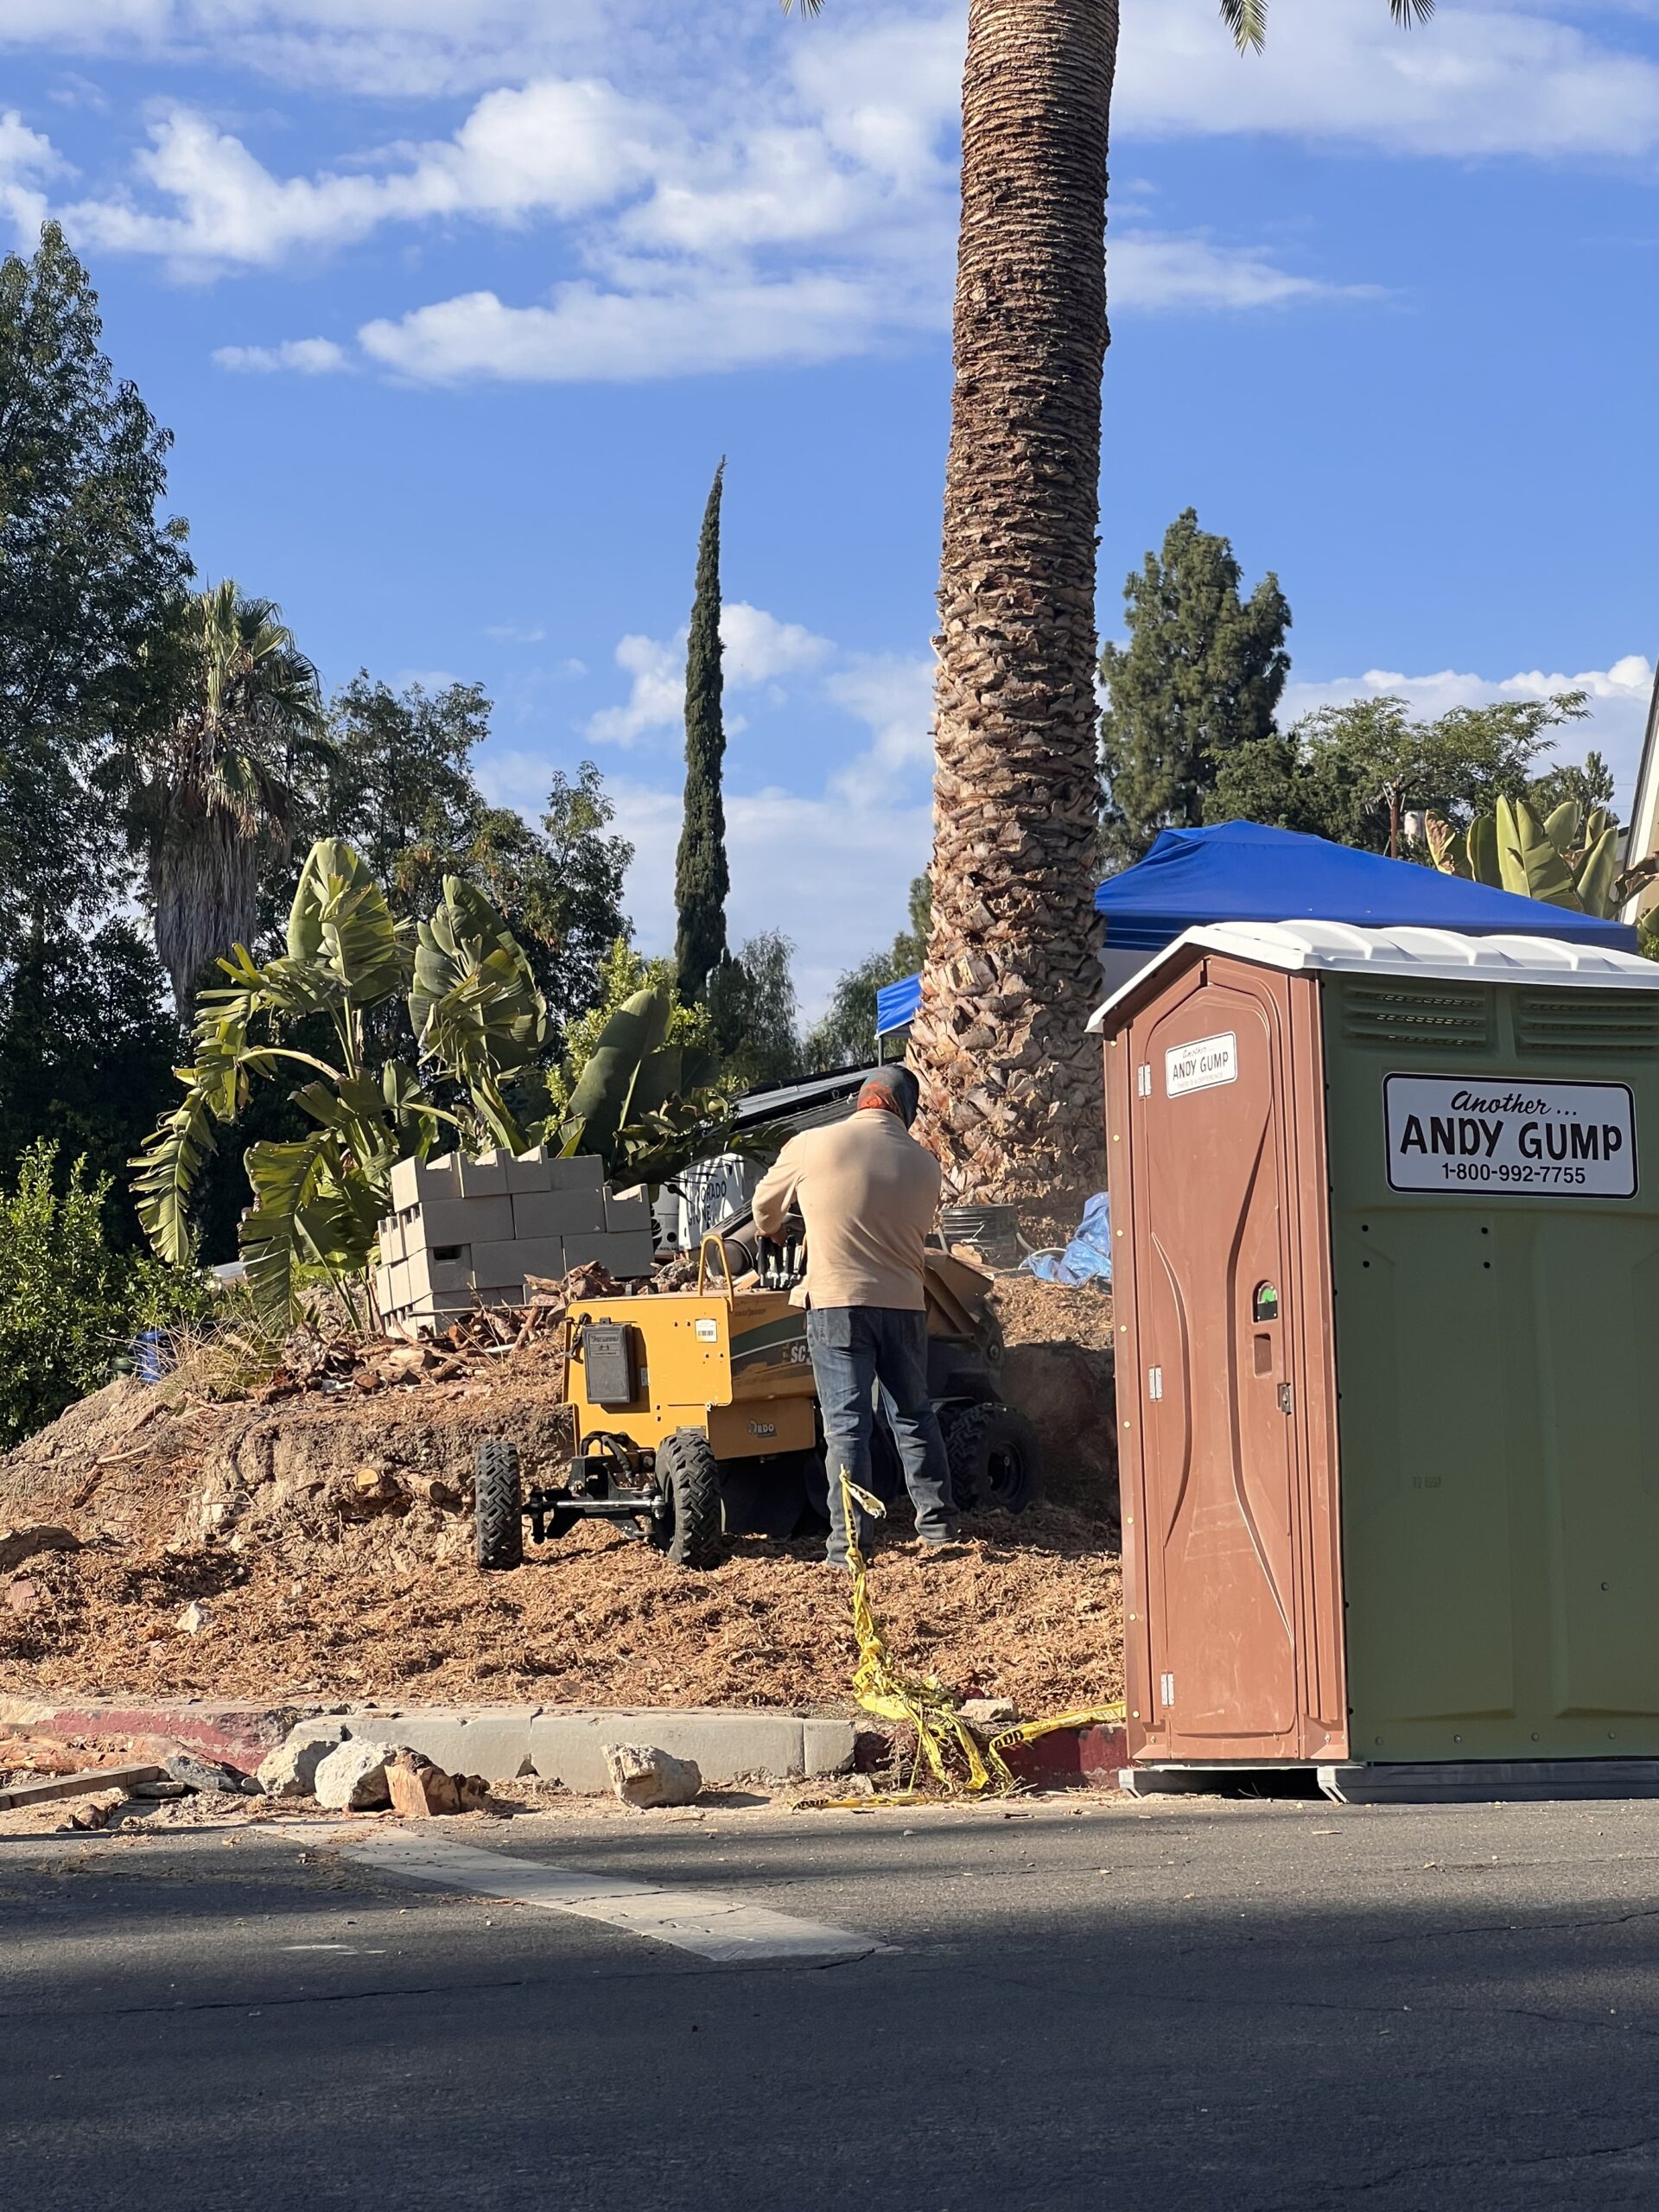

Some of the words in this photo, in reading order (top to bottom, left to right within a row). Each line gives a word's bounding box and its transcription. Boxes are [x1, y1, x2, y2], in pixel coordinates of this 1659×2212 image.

[1173, 1058, 1197, 1082] ANDY
[1199, 1051, 1229, 1073] GUMP
[1400, 1114, 1504, 1158] ANDY
[1518, 1122, 1623, 1161] GUMP
[1441, 1162, 1586, 1185] 1-800-992-7755
